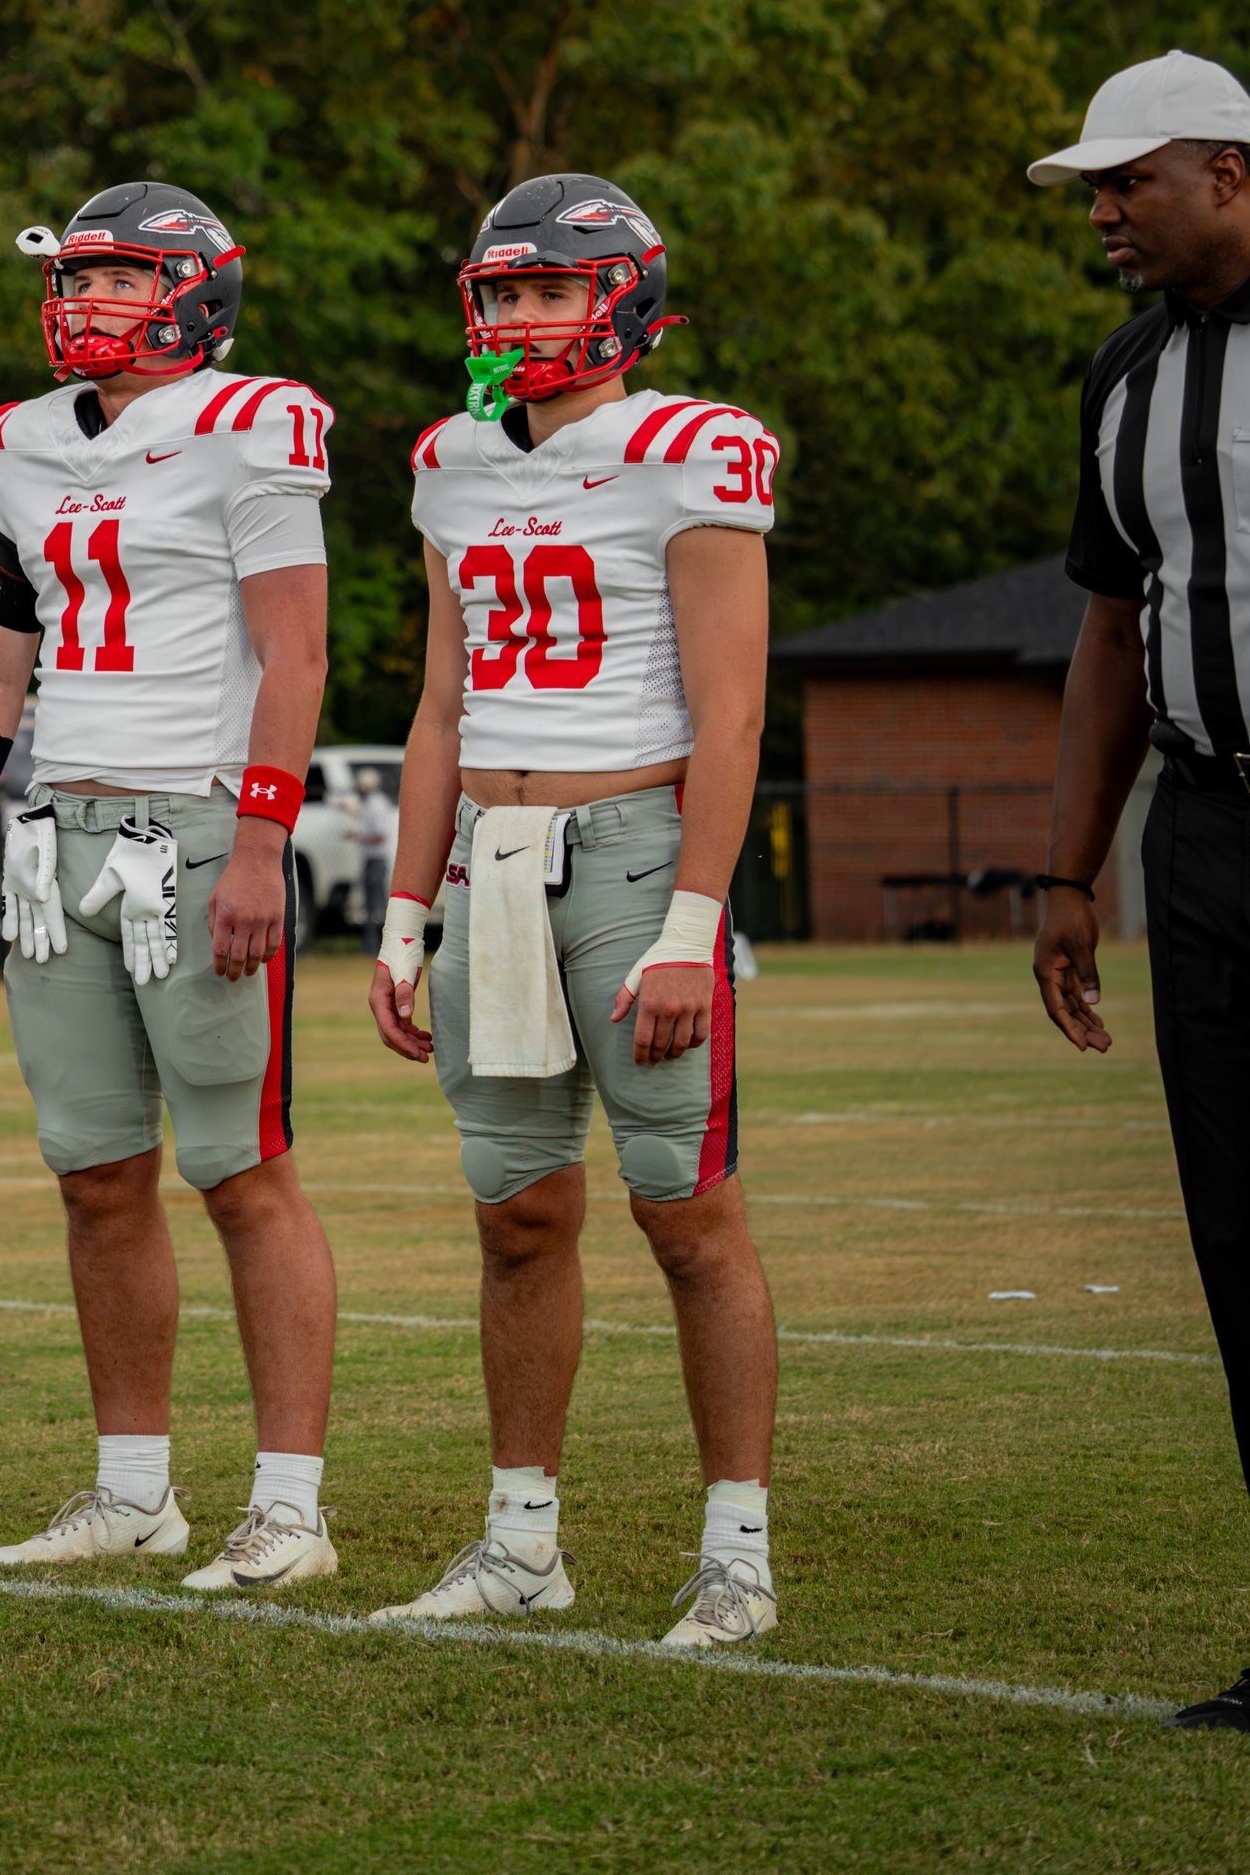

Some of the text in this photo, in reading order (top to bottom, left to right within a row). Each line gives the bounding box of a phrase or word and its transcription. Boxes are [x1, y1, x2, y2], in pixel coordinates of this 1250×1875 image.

[68, 232, 107, 243] Riddell
[487, 246, 530, 258] Riddell
[286, 404, 325, 472] 11
[711, 435, 778, 506] 30
[55, 494, 126, 515] Lee-Scott
[488, 517, 563, 537] Lee-Scott
[44, 519, 134, 672] 11
[459, 544, 608, 691] 30
[446, 863, 471, 887] SA
